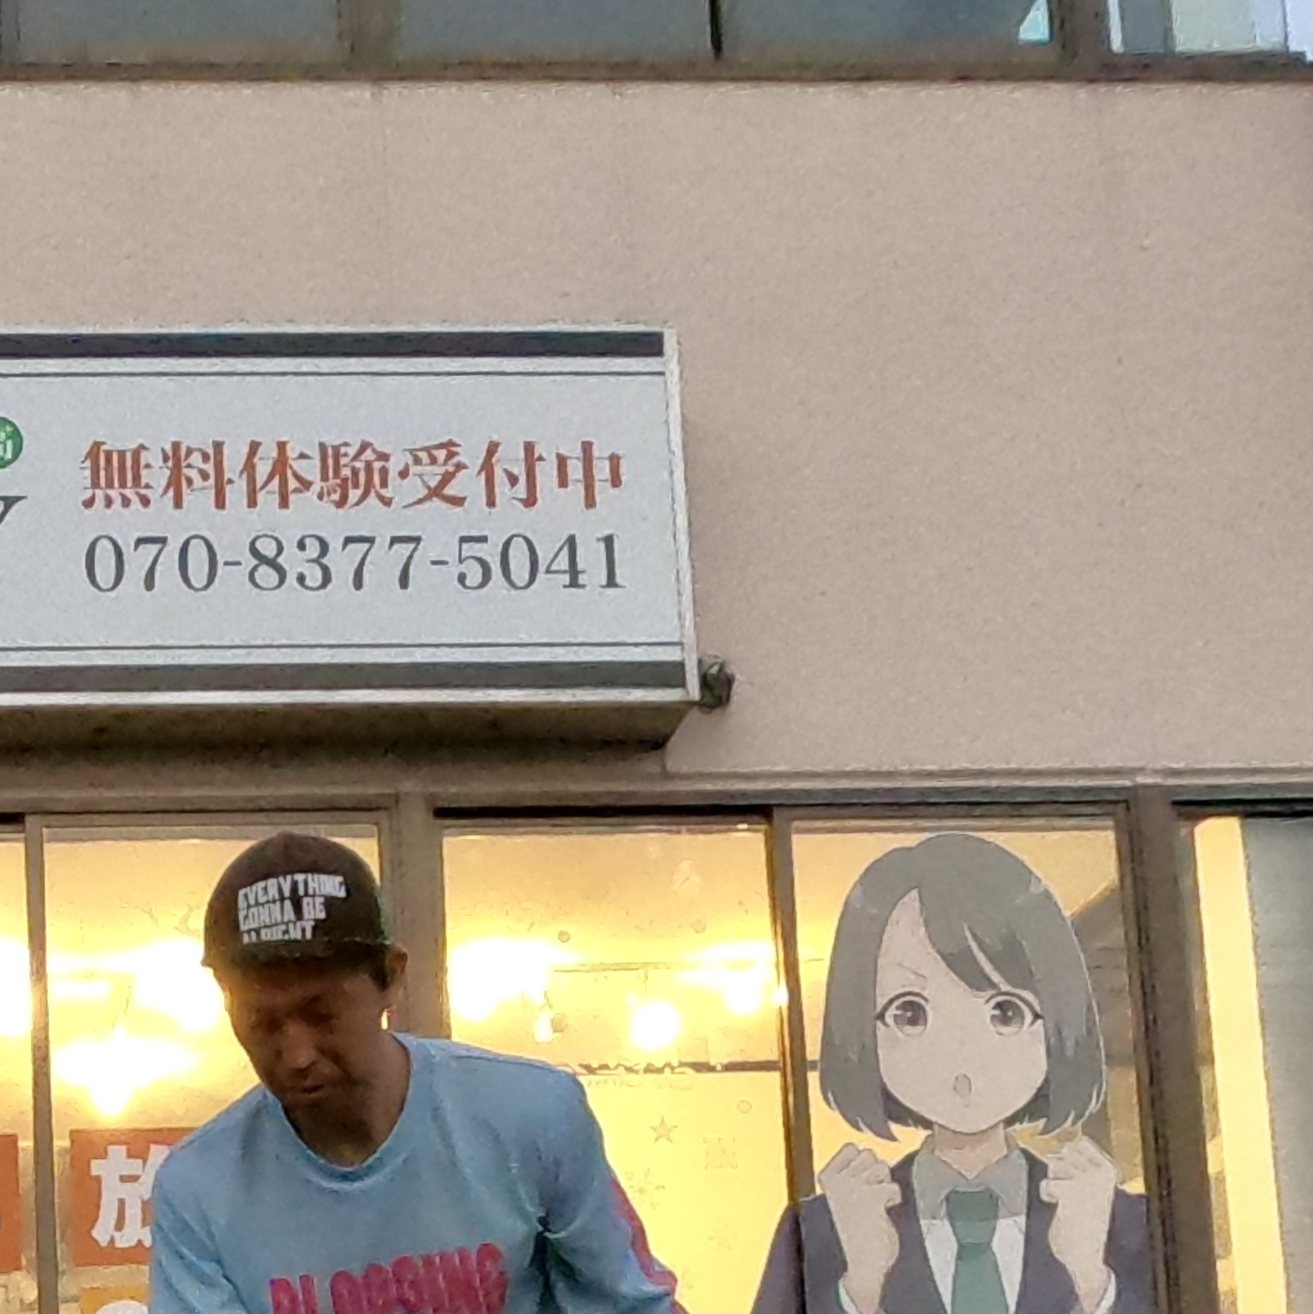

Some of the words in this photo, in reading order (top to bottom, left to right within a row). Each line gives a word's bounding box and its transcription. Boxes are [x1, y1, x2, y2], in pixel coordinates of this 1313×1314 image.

[81, 438, 624, 512] 無料体験受付中
[85, 532, 626, 593] 070-8377-5041
[238, 873, 347, 911] EVERYTHING
[239, 899, 295, 931] GONNA
[303, 896, 327, 919] BE
